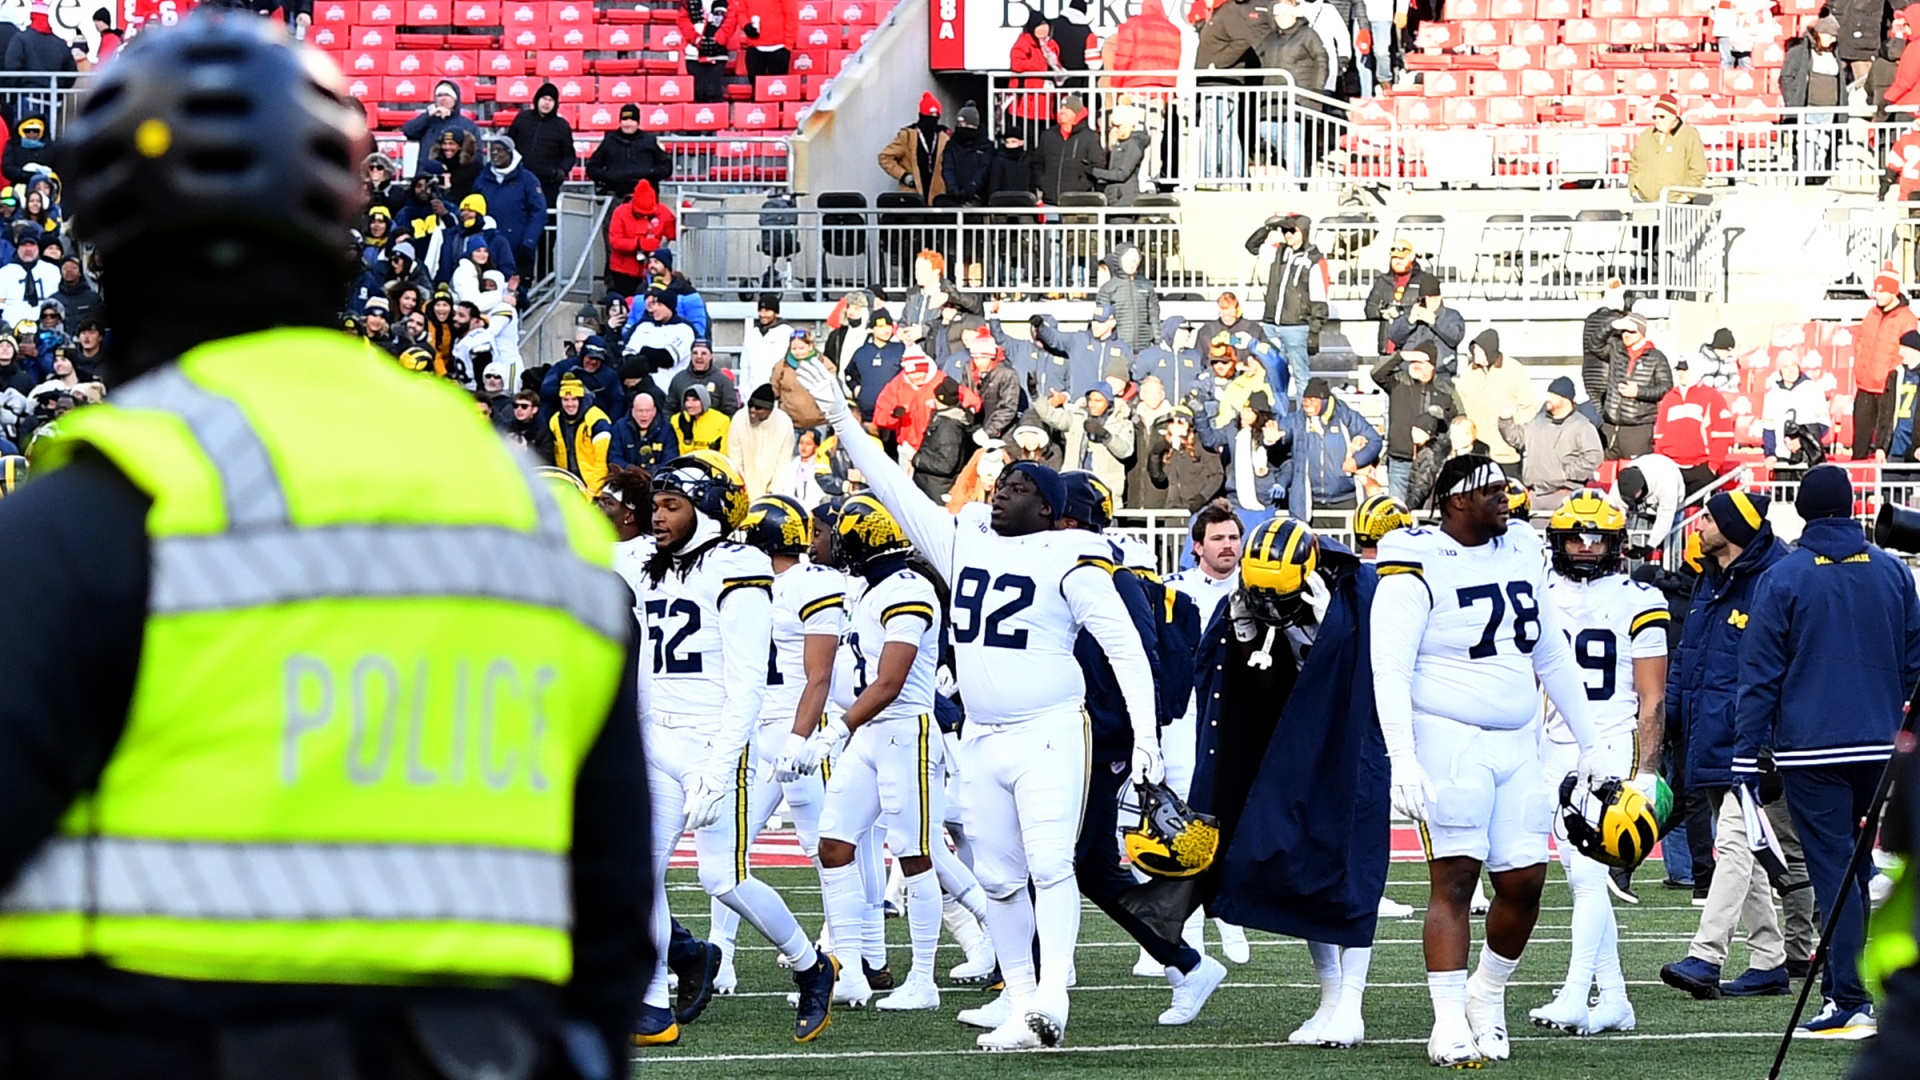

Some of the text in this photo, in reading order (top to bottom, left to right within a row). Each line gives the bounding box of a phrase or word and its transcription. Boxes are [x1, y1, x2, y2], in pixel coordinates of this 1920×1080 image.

[411, 214, 436, 239] M
[951, 566, 1037, 650] 92
[1456, 580, 1541, 660] 78
[1727, 609, 1749, 629] M
[1562, 628, 1617, 701] 9
[280, 654, 557, 791] POLICE
